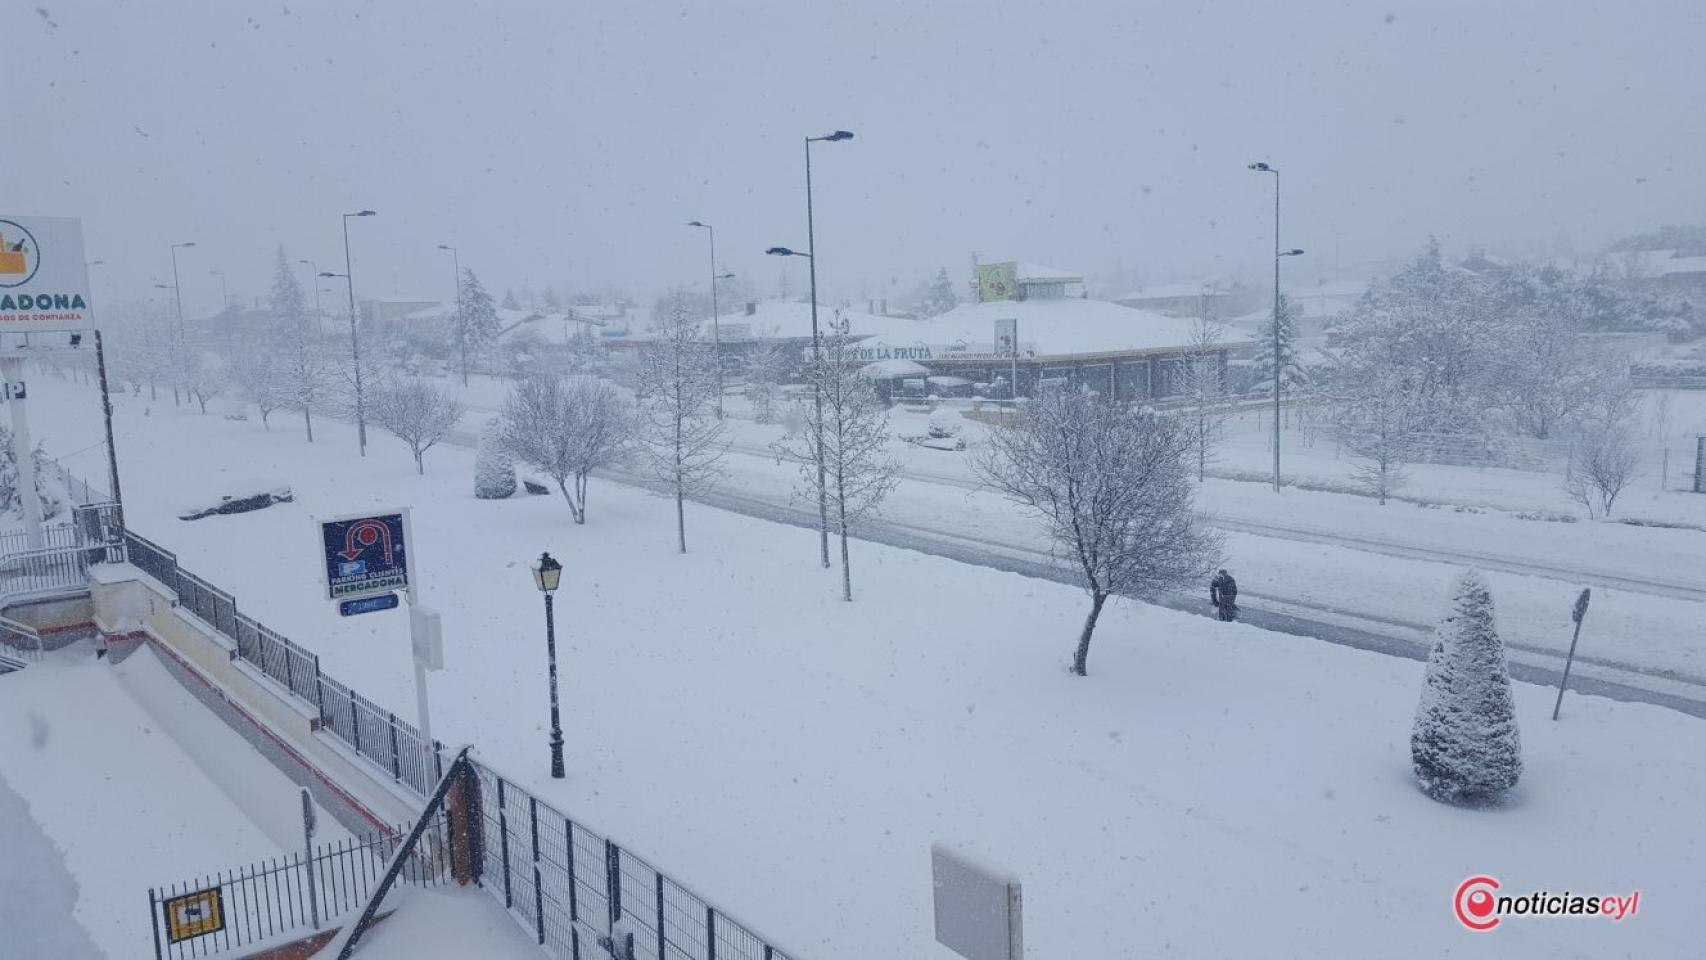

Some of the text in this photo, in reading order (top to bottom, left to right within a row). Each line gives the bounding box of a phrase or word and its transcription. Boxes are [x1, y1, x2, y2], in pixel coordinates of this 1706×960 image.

[0, 294, 86, 310] ADONA
[861, 348, 874, 360] DE
[877, 347, 891, 360] LA
[894, 346, 932, 360] FRUTA
[9, 382, 24, 400] P
[330, 574, 367, 584] PARKING
[334, 577, 403, 594] MERCADONA
